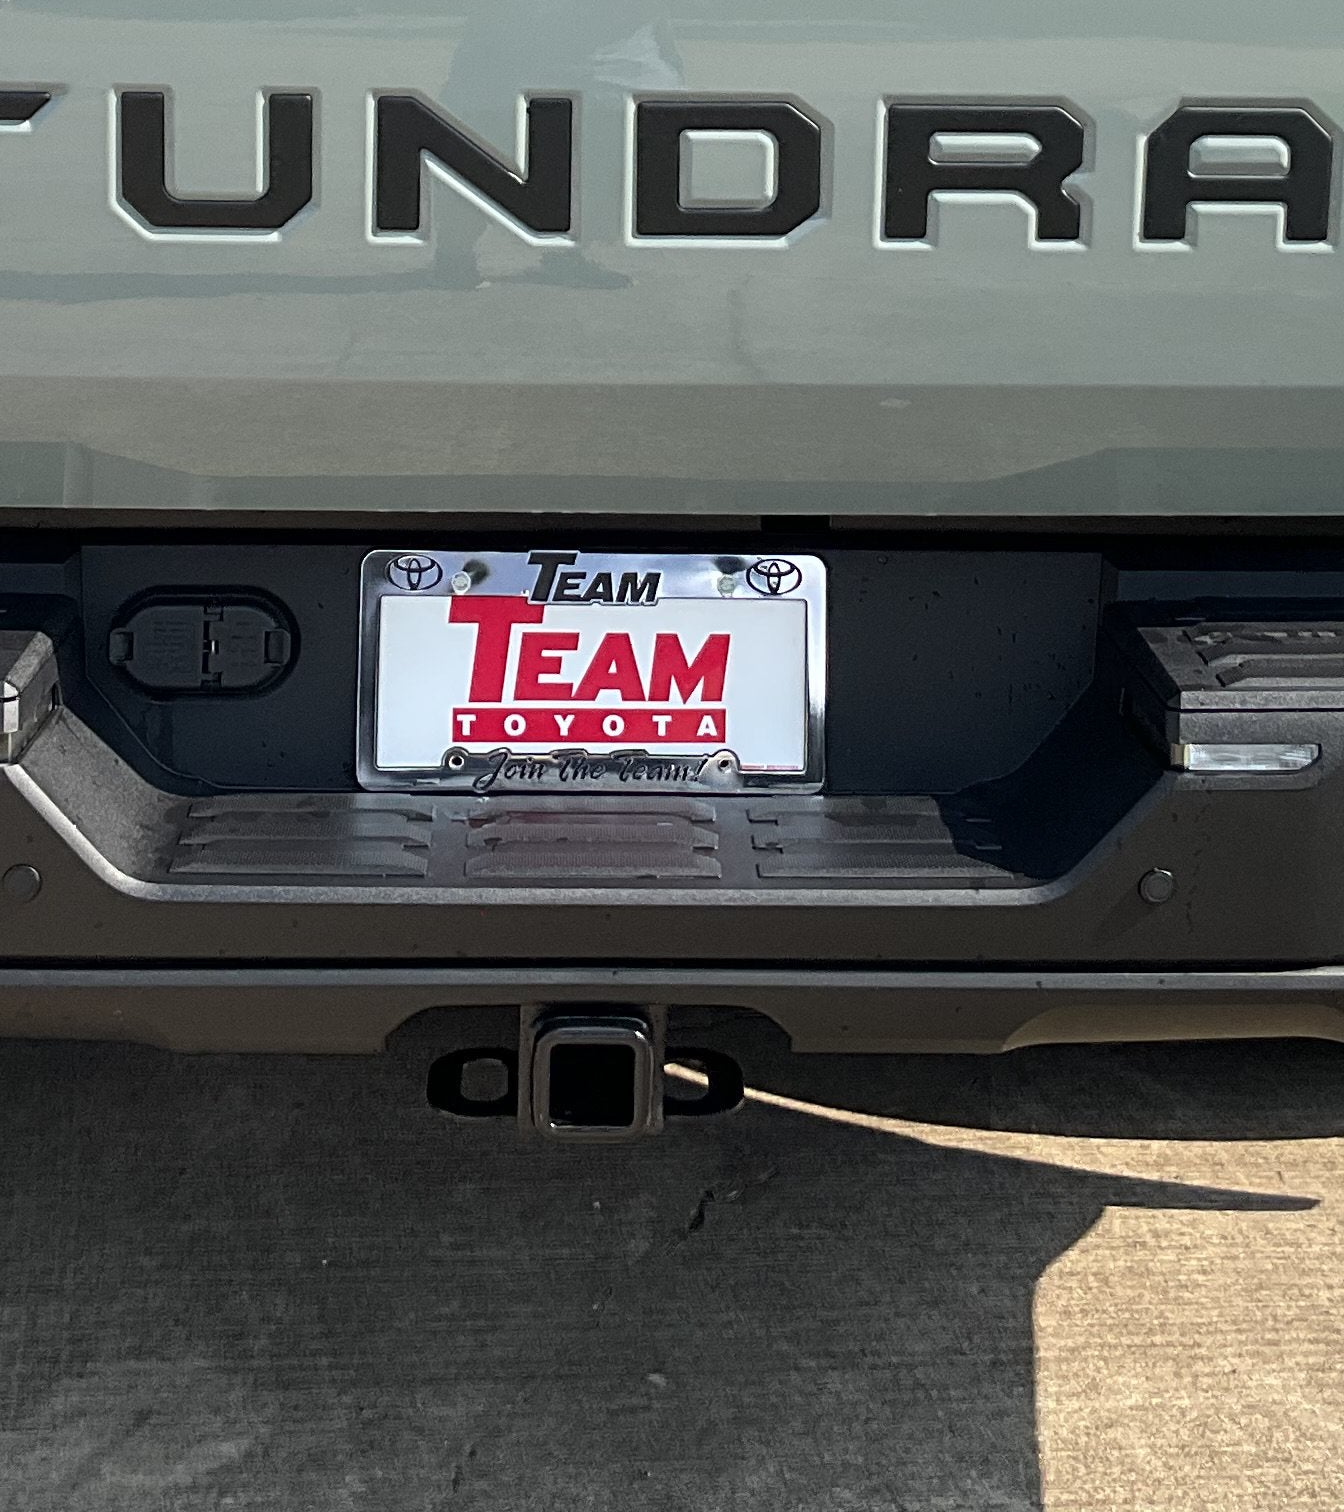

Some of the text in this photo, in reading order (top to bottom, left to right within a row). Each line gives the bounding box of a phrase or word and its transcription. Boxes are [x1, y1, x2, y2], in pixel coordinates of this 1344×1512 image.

[527, 550, 662, 603] TEAM
[448, 594, 732, 704] TEAM
[456, 713, 719, 737] TOYOTA
[472, 749, 709, 790] Join The Team!
